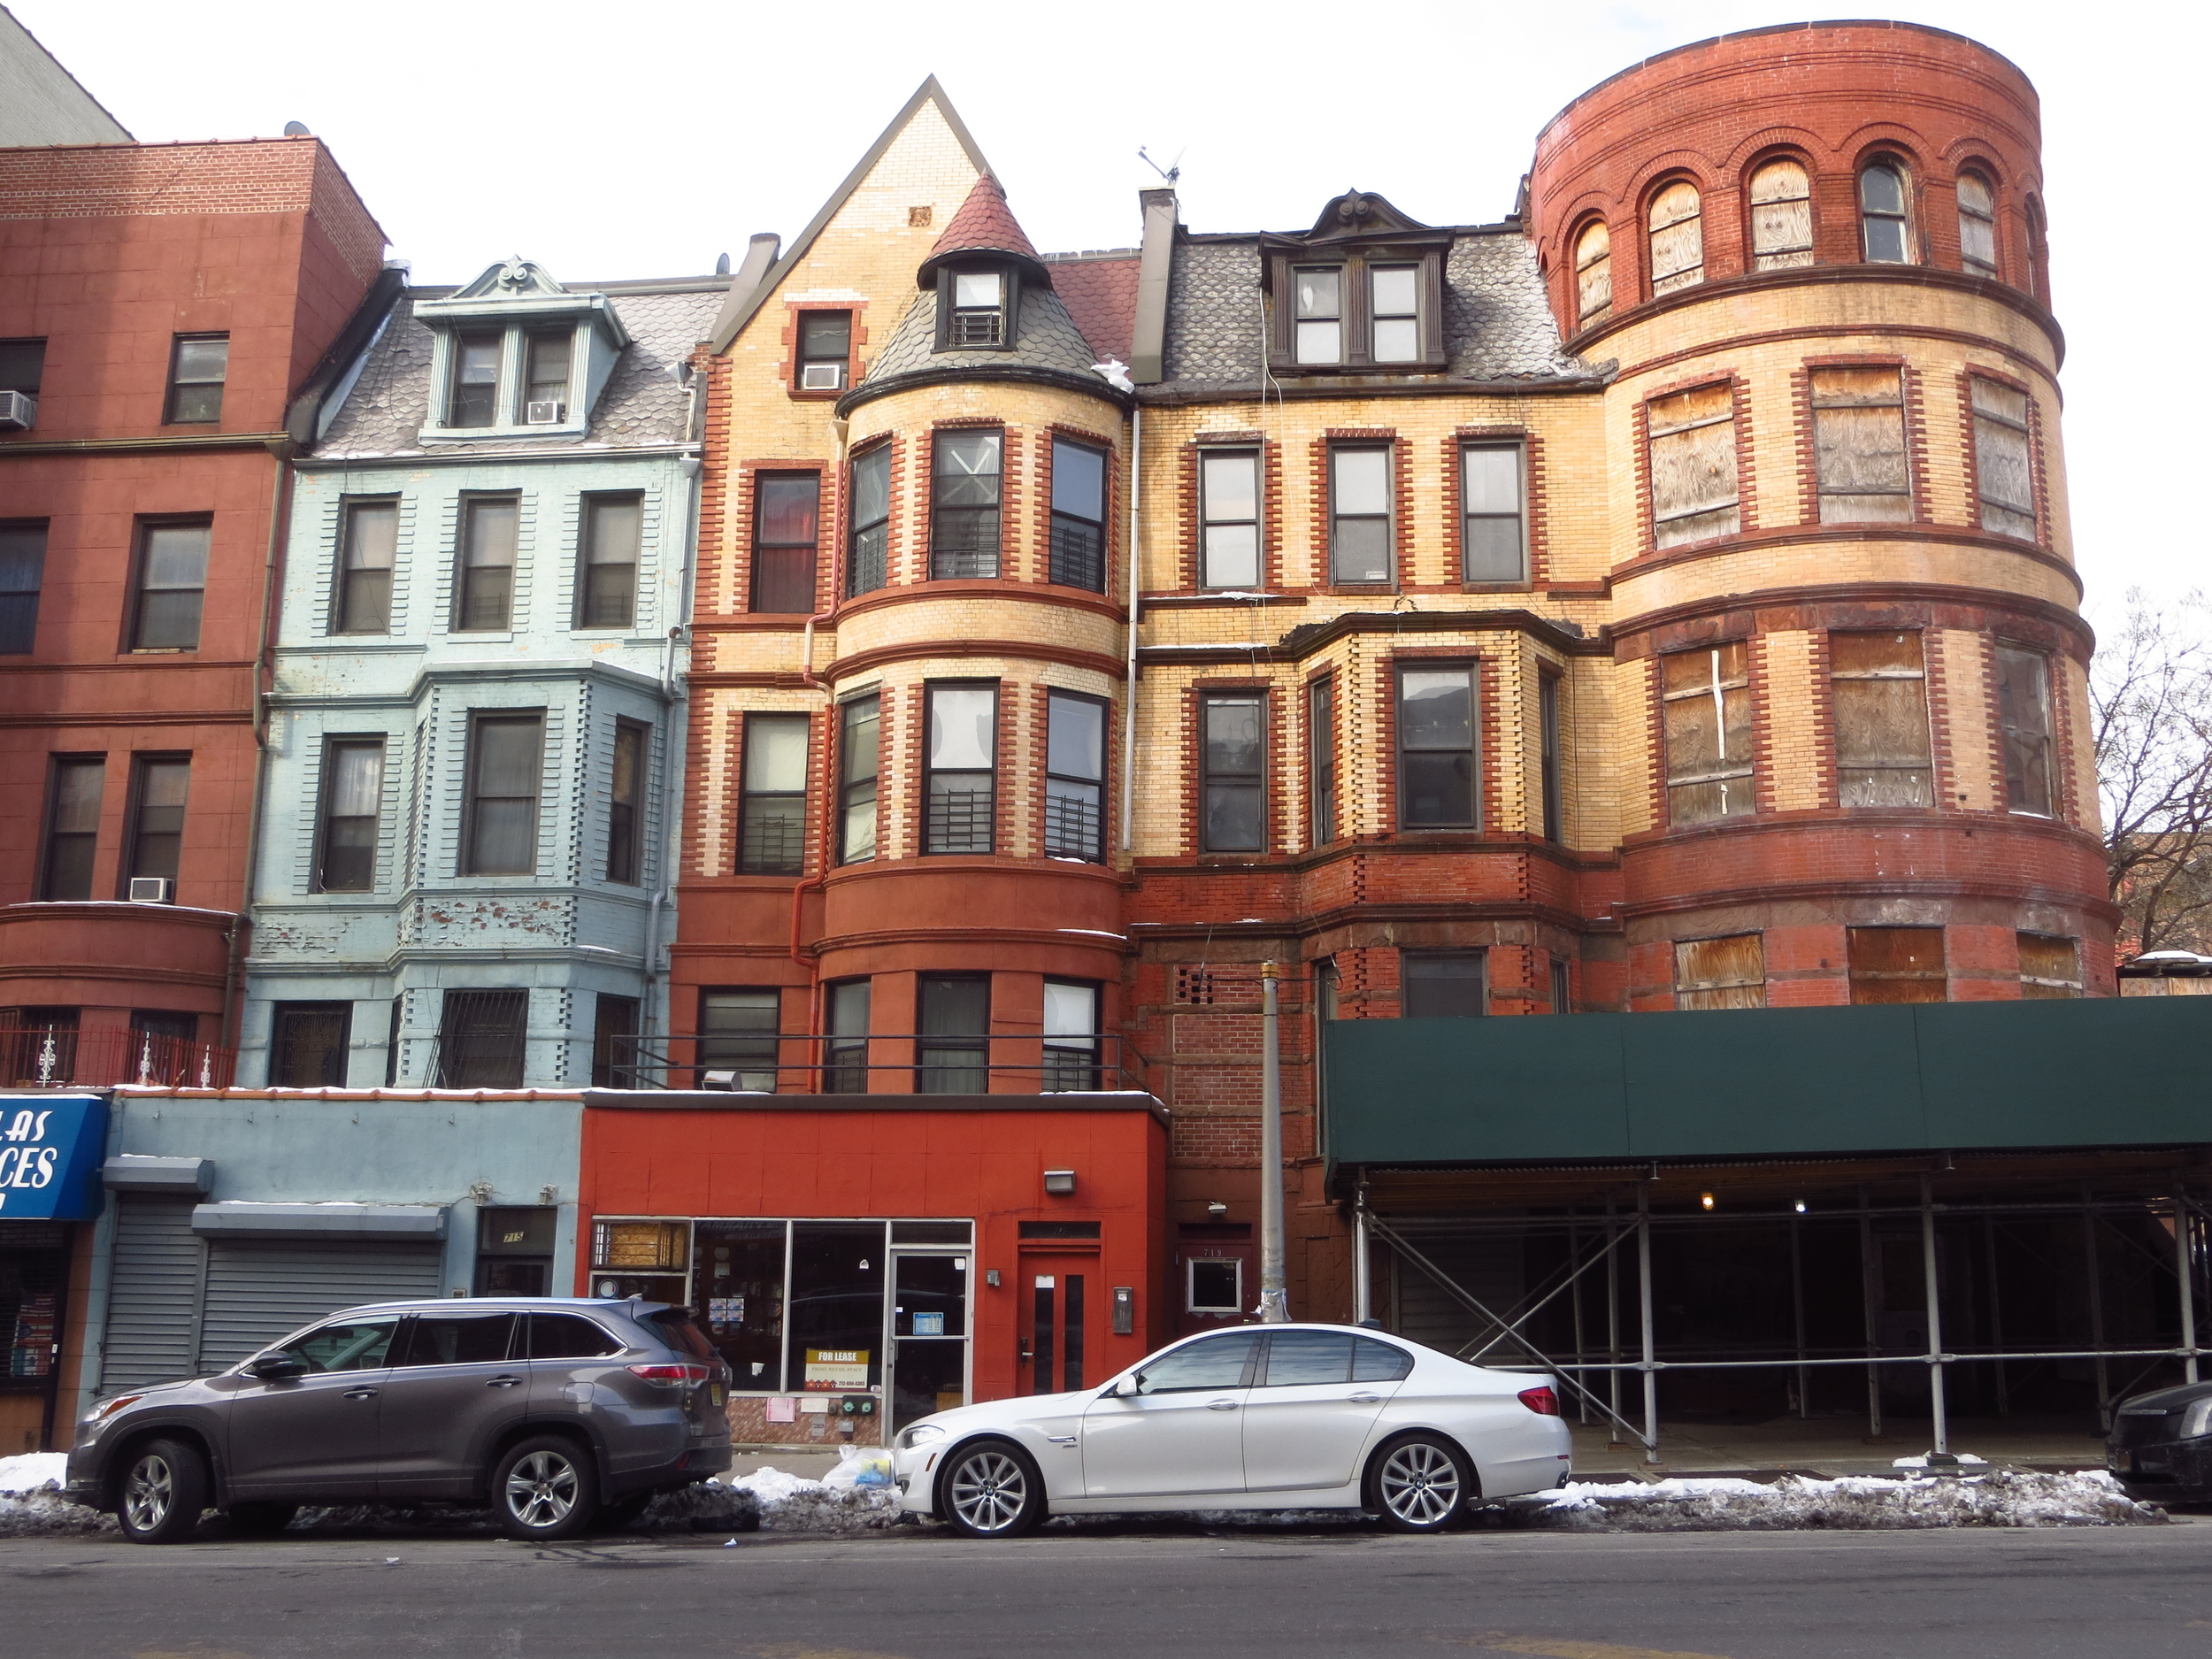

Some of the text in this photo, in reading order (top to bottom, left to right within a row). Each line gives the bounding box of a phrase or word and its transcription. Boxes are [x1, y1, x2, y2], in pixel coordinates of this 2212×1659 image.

[505, 1232, 522, 1242] 715
[818, 1352, 857, 1361] FOR LEASE
